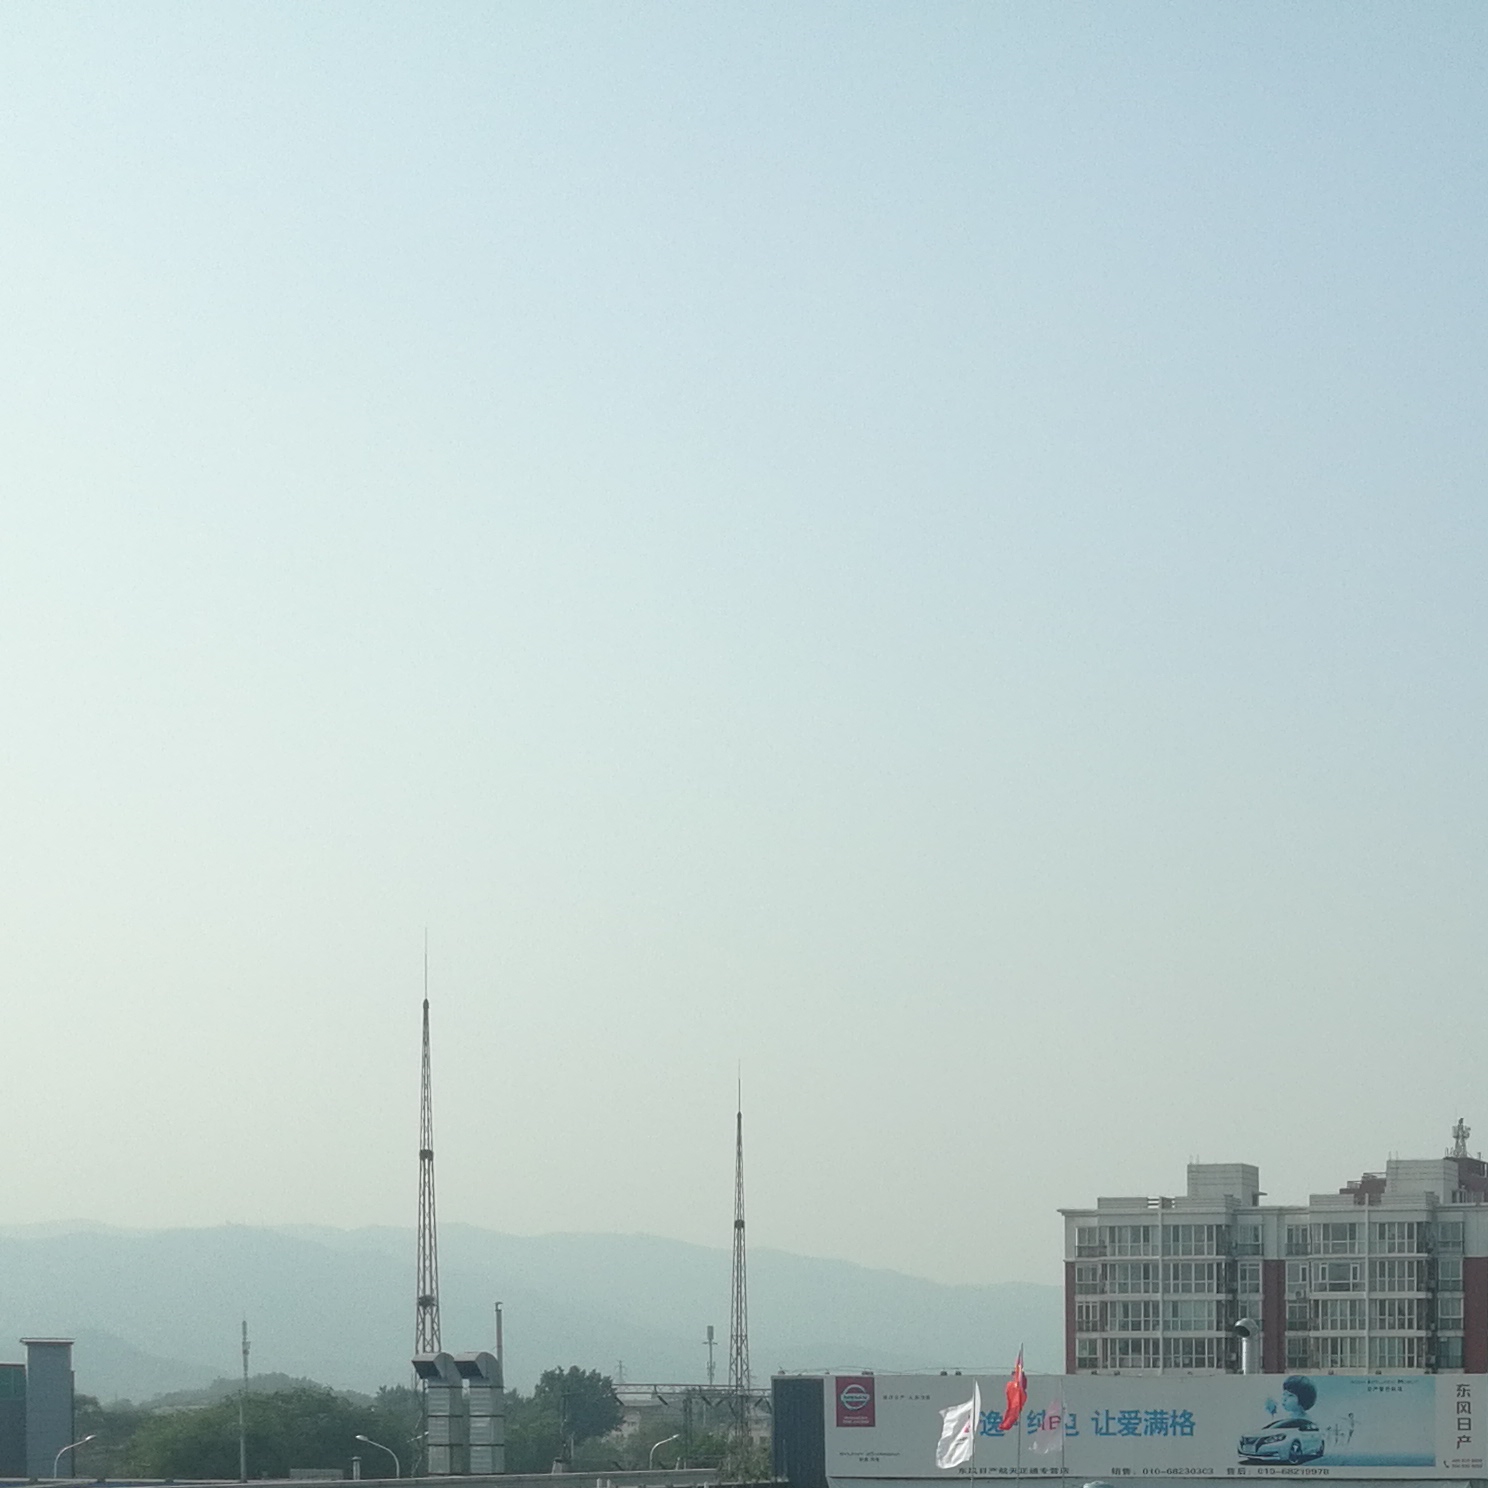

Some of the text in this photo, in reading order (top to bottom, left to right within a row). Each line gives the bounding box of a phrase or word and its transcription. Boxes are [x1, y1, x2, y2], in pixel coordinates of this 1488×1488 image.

[1091, 1409, 1196, 1438] 让爱满格
[1456, 1383, 1472, 1450] 东风日产
